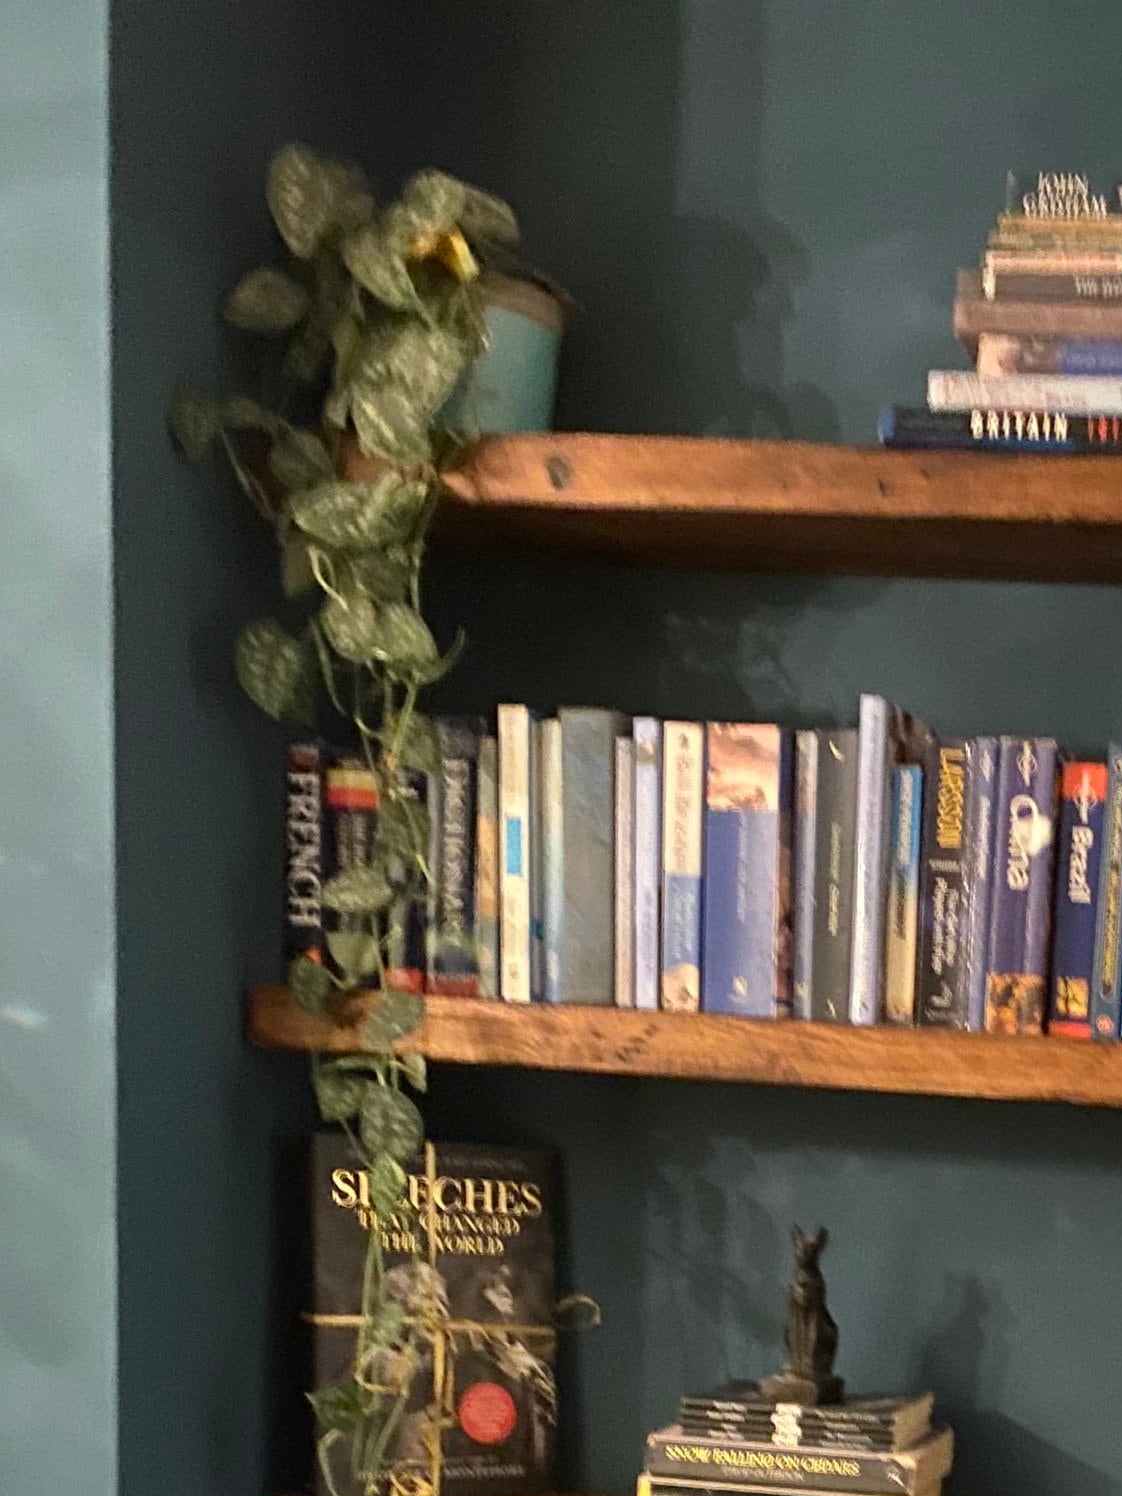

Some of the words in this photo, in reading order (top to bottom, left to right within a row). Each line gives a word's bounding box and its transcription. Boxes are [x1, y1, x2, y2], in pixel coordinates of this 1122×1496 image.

[969, 409, 1069, 442] BRITAIN
[288, 771, 321, 928] FRENCH
[1068, 825, 1095, 904] Brazil
[332, 1168, 543, 1217] SECHES
[665, 1444, 711, 1463] SNOW
[712, 1447, 775, 1469] FALLING
[775, 1453, 800, 1471] ON
[801, 1455, 861, 1477] CEDARS
